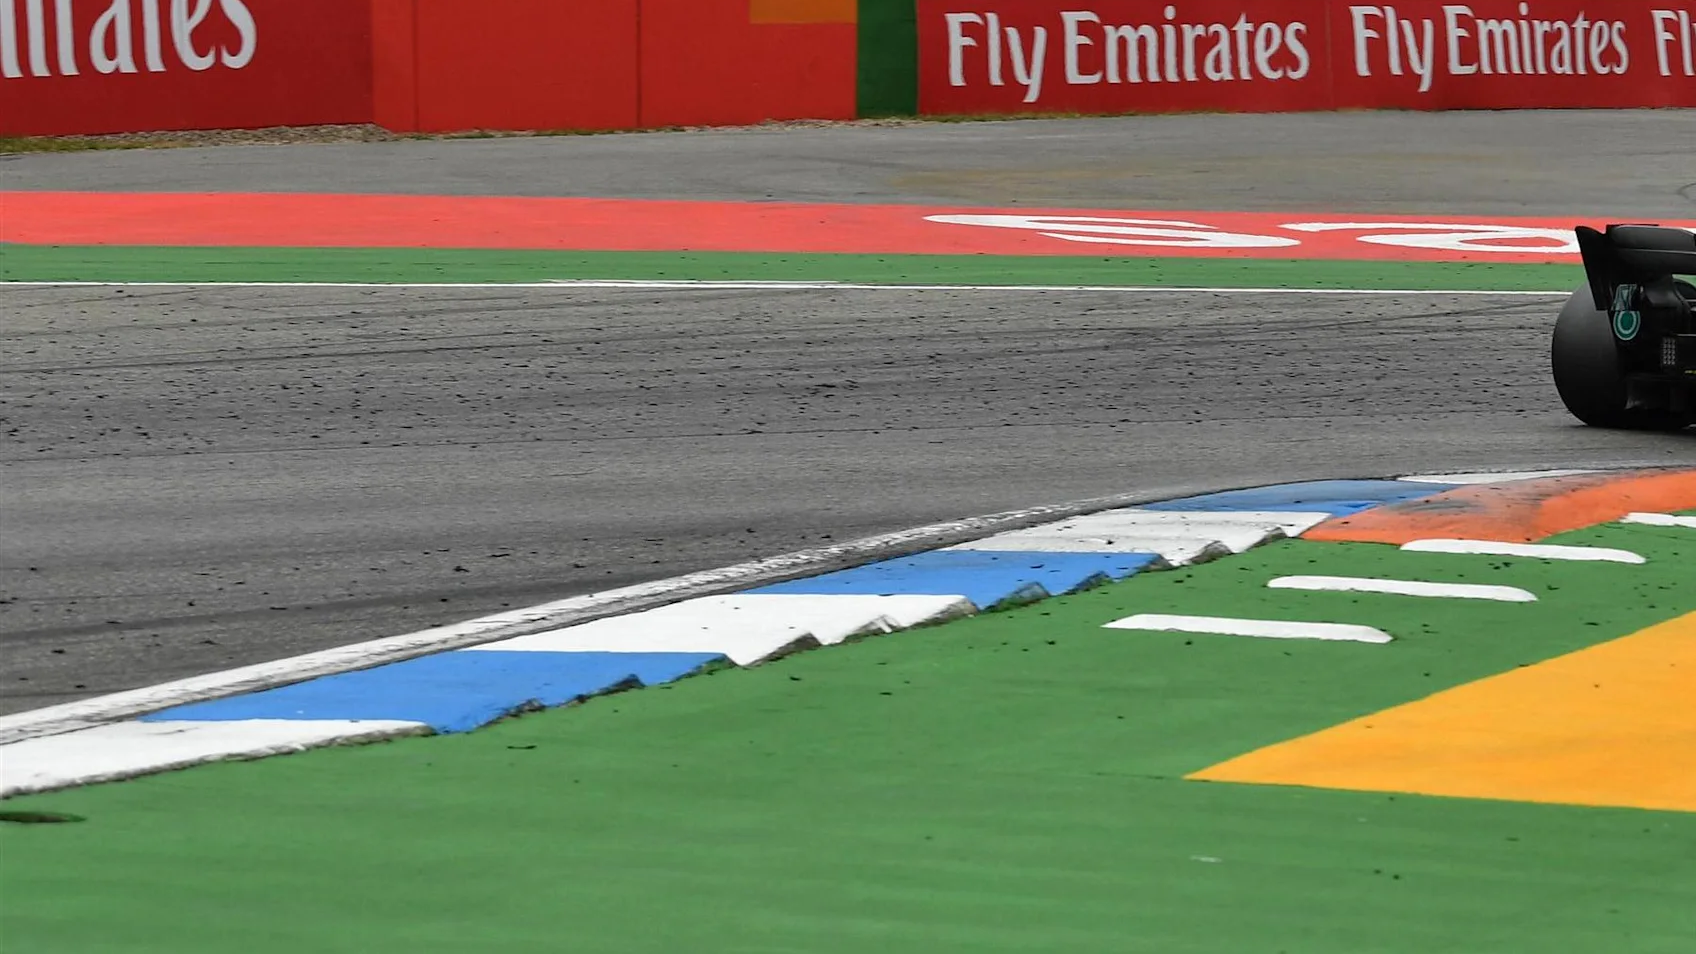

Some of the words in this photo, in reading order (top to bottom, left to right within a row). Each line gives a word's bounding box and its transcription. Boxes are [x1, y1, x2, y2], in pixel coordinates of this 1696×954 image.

[945, 11, 1047, 103] Fly
[1061, 5, 1310, 85] Emirates
[1349, 5, 1433, 92] Fly
[1443, 2, 1629, 76] Emirates
